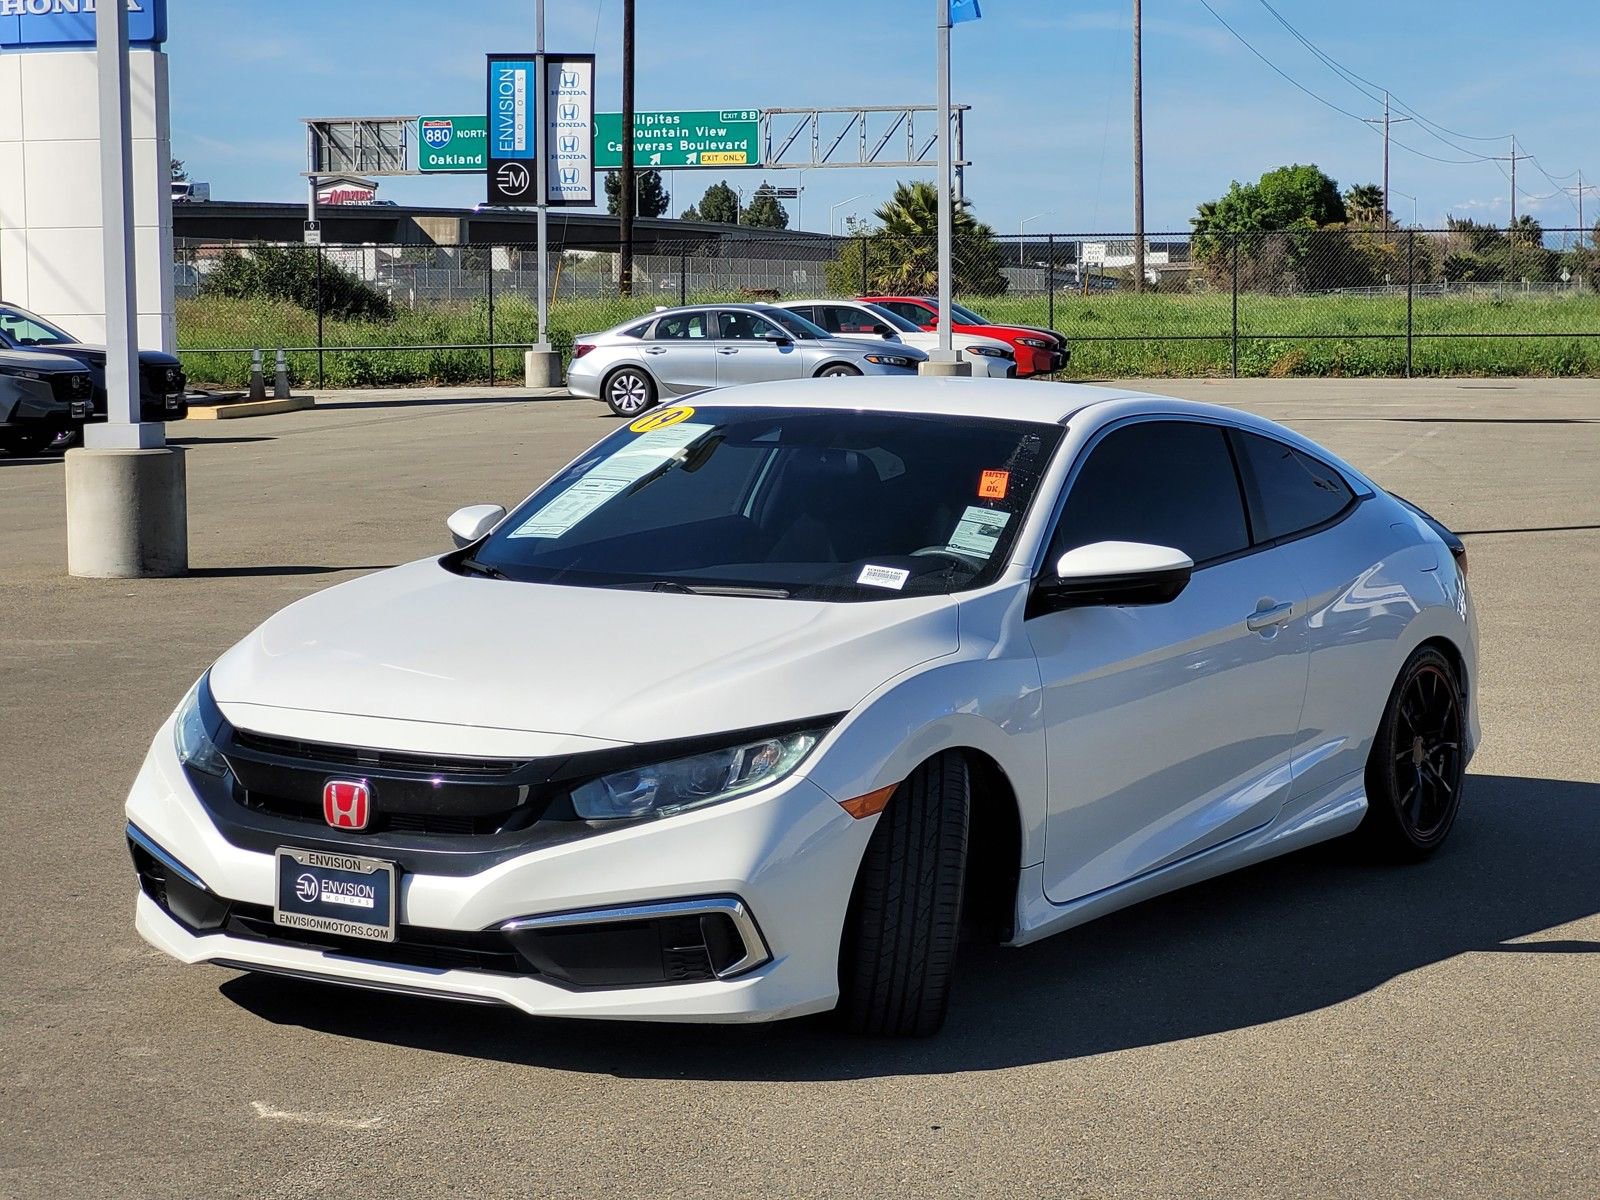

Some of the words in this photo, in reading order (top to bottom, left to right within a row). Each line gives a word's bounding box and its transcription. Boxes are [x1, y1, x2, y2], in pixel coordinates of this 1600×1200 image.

[499, 69, 514, 151] ENVISION
[633, 114, 680, 127] ilpitas
[426, 129, 450, 142] 880
[633, 127, 689, 138] ountain
[696, 126, 727, 137] View
[607, 141, 673, 152] Caveras
[680, 139, 748, 151] Boulevard
[429, 154, 482, 165] Oakland
[984, 471, 1007, 479] SAFETY
[986, 485, 998, 493] OK
[308, 854, 361, 871] ENVISION
[321, 879, 375, 898] ENVISION
[279, 914, 389, 939] ENVISIONMOTORS.COM
